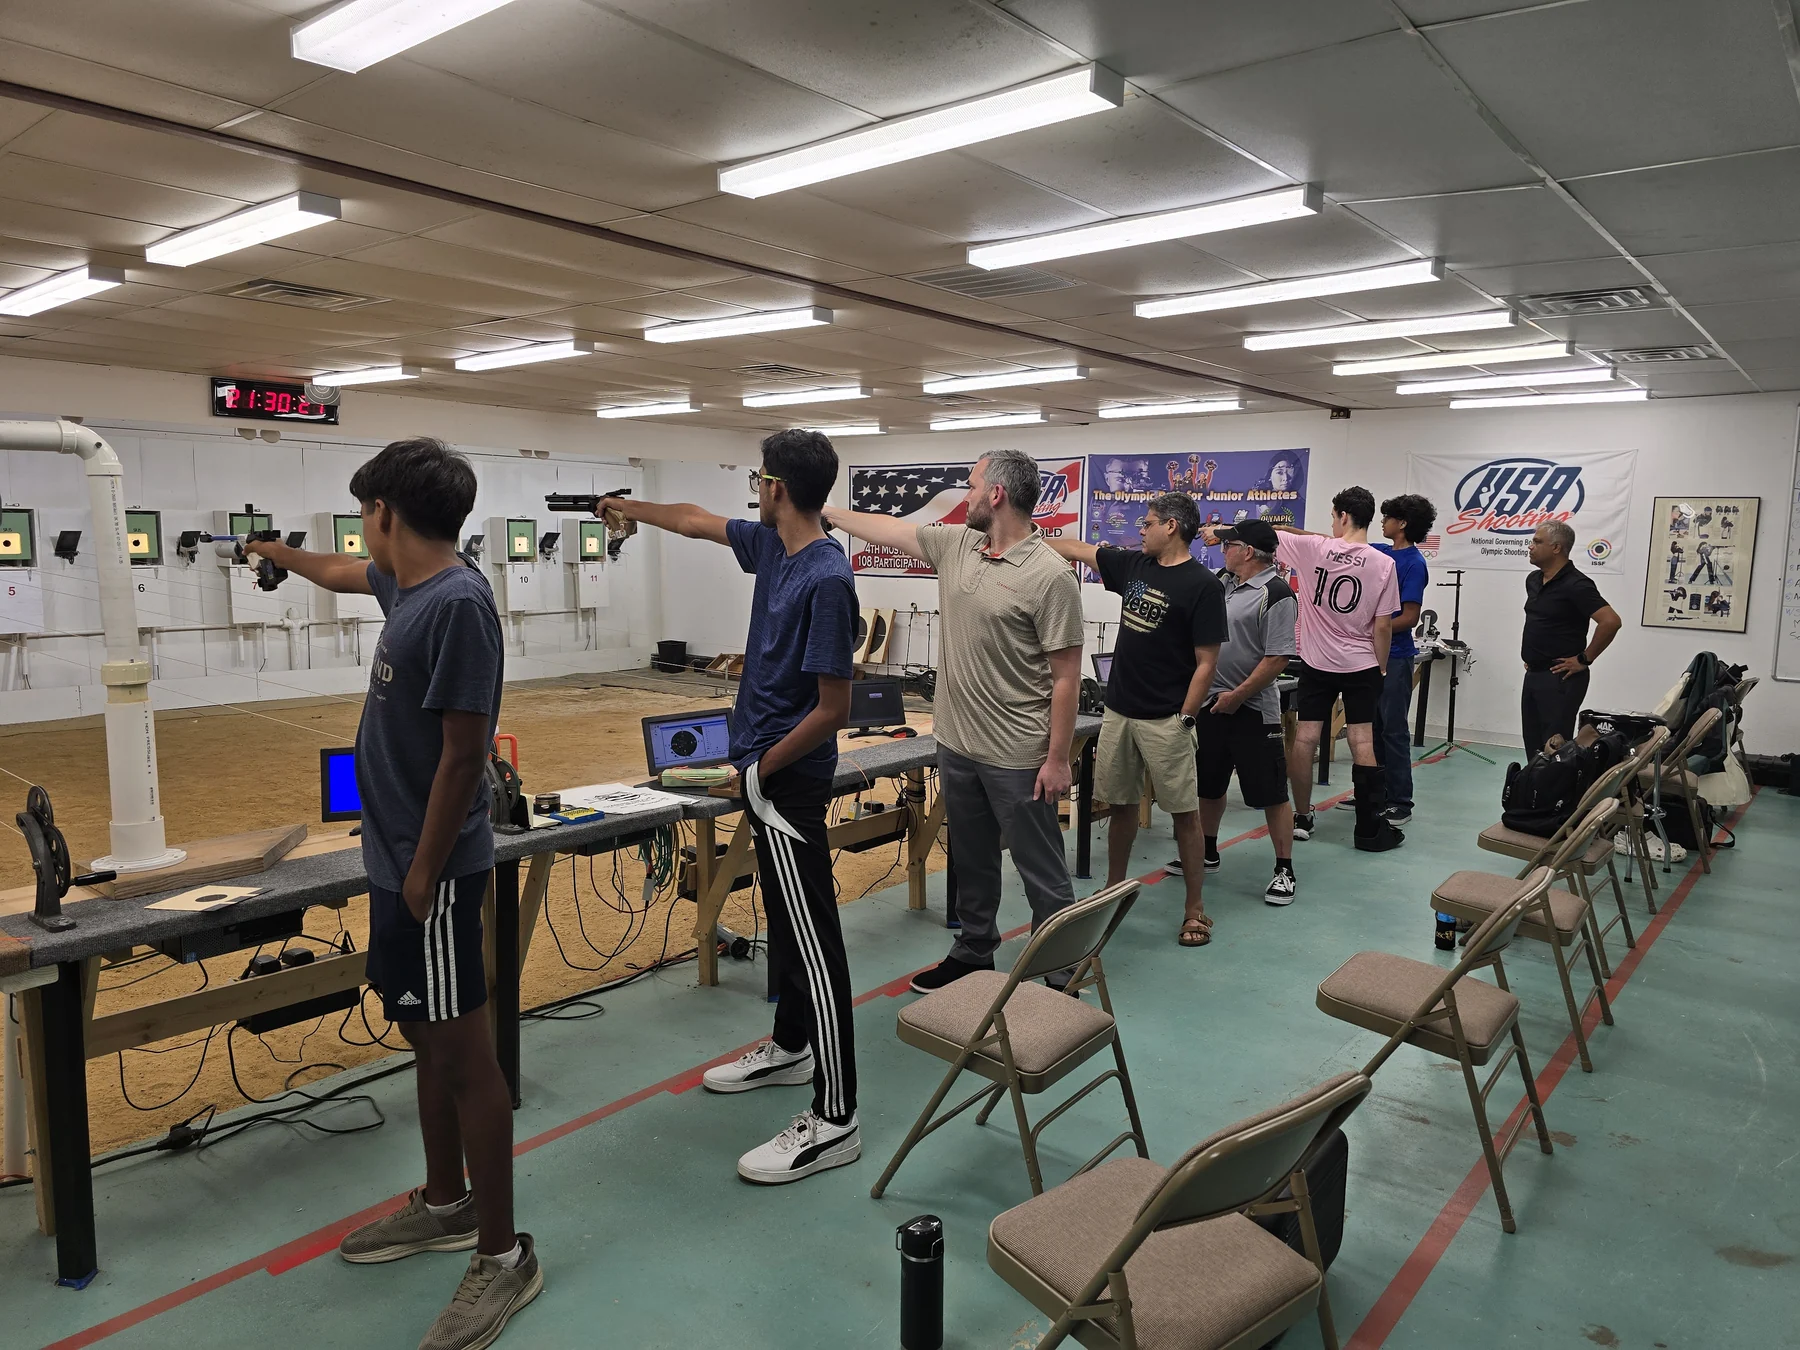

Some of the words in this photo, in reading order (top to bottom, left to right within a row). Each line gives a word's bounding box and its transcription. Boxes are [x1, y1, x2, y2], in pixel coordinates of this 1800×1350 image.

[1093, 490, 1112, 501] The
[1114, 490, 1155, 503] Olympic
[1206, 490, 1244, 501] Junior
[1246, 490, 1298, 501] Athletes
[1461, 466, 1583, 517] USA
[1260, 514, 1292, 523] OLYMPIC
[1495, 538, 1523, 547] Governing
[865, 543, 880, 554] 4TH
[1480, 548, 1503, 556] Olympic
[1504, 548, 1529, 557] Shooting
[858, 555, 873, 567] 108
[1326, 549, 1366, 568] MESSI
[138, 583, 145, 592] 6
[251, 581, 258, 590] 7
[1313, 566, 1362, 614] 10
[8, 586, 16, 596] 5
[1124, 589, 1162, 622] Jeep
[397, 998, 422, 1006] adidas
